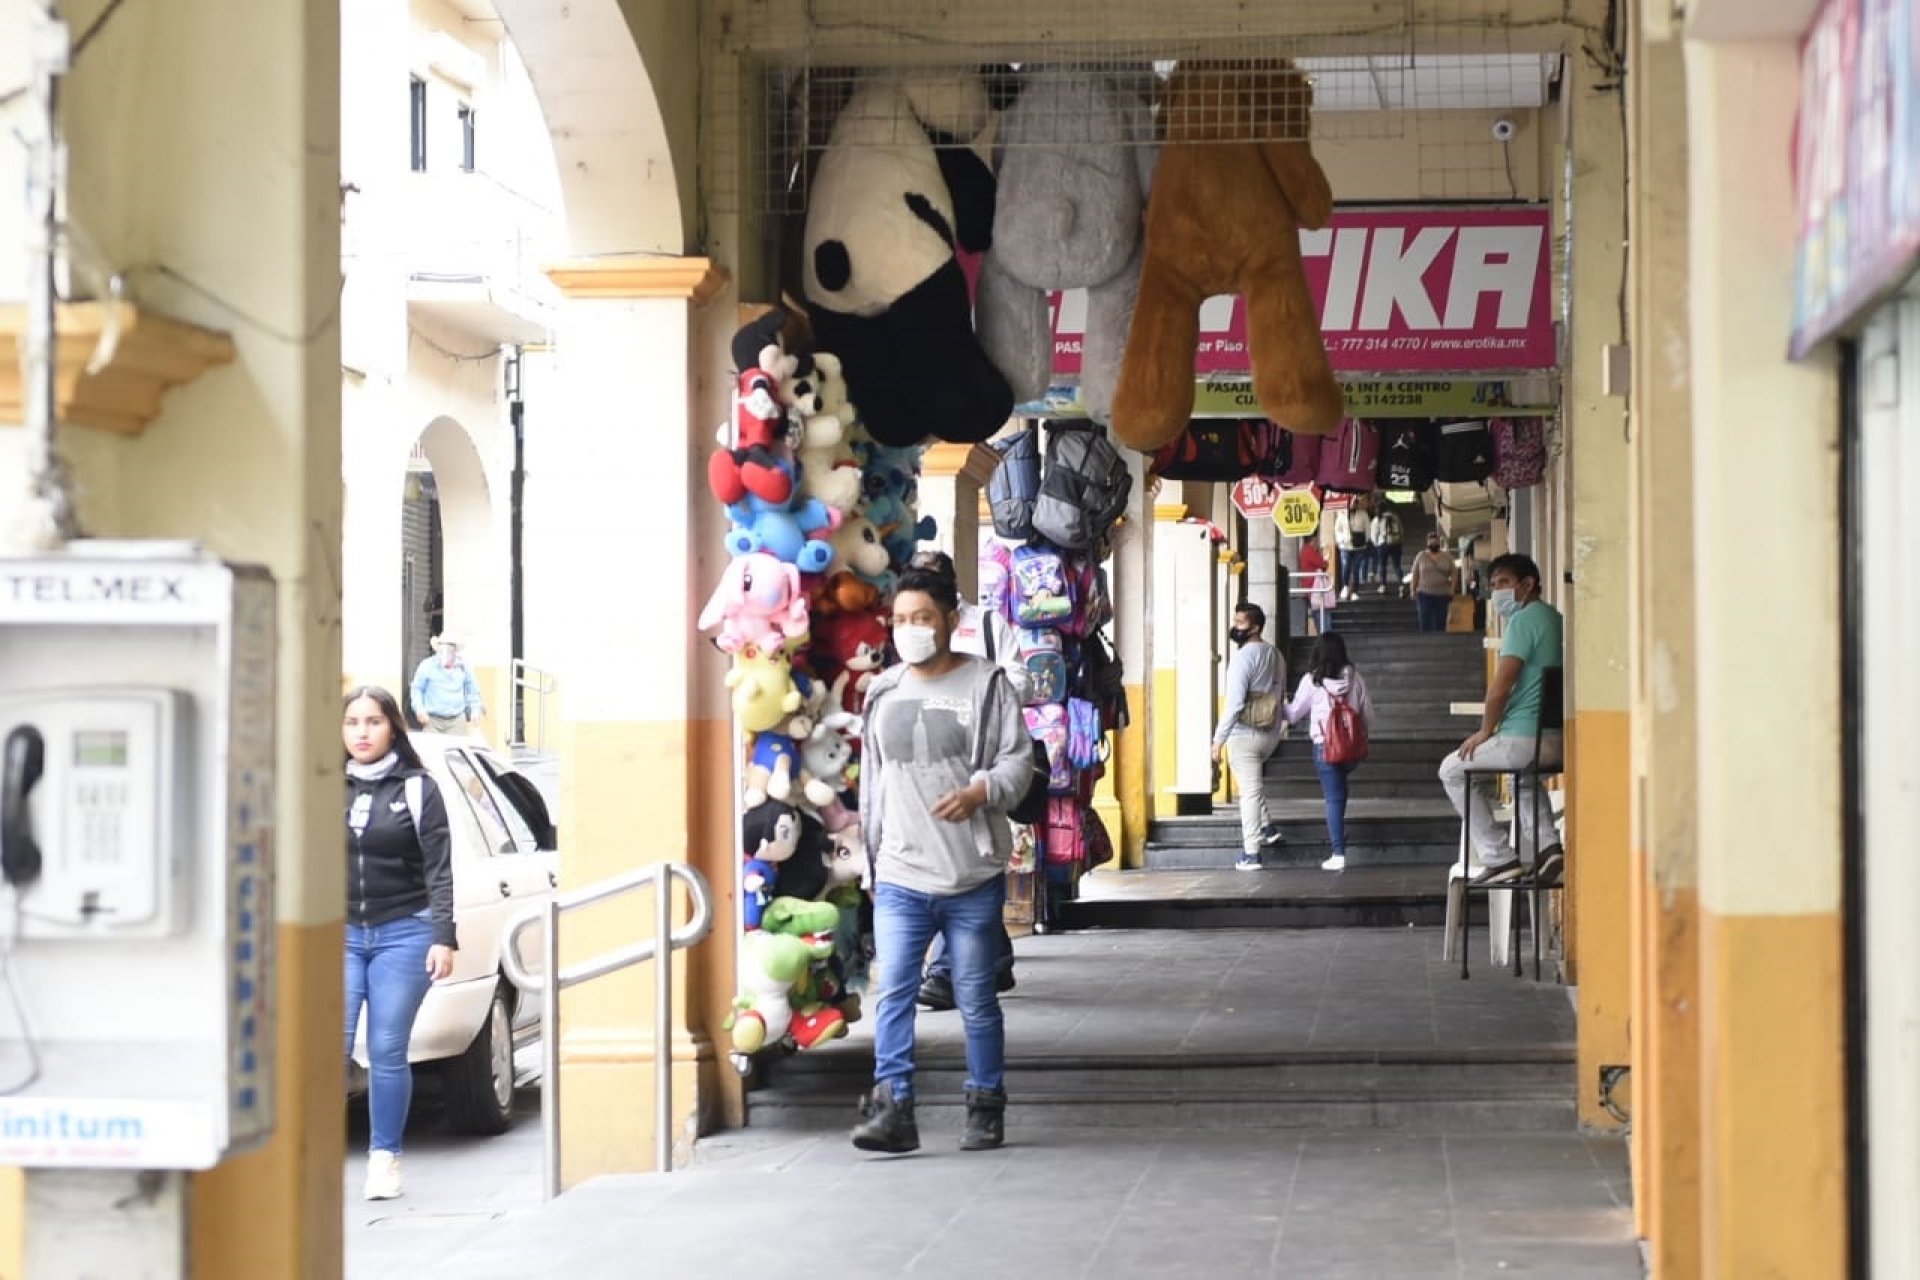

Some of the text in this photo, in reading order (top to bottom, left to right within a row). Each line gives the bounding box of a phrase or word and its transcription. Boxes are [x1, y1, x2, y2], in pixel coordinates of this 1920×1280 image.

[1215, 339, 1243, 351] Piso
[1341, 338, 1364, 351] 777
[1365, 337, 1389, 350] 314
[1391, 337, 1420, 350] 4770
[1430, 335, 1528, 349] www.erotika.mx
[1358, 382, 1381, 392] INT
[1385, 382, 1393, 392] 4
[1397, 382, 1452, 392] CENTRO
[1284, 503, 1315, 524] 30%
[8, 576, 184, 601] TELMEX
